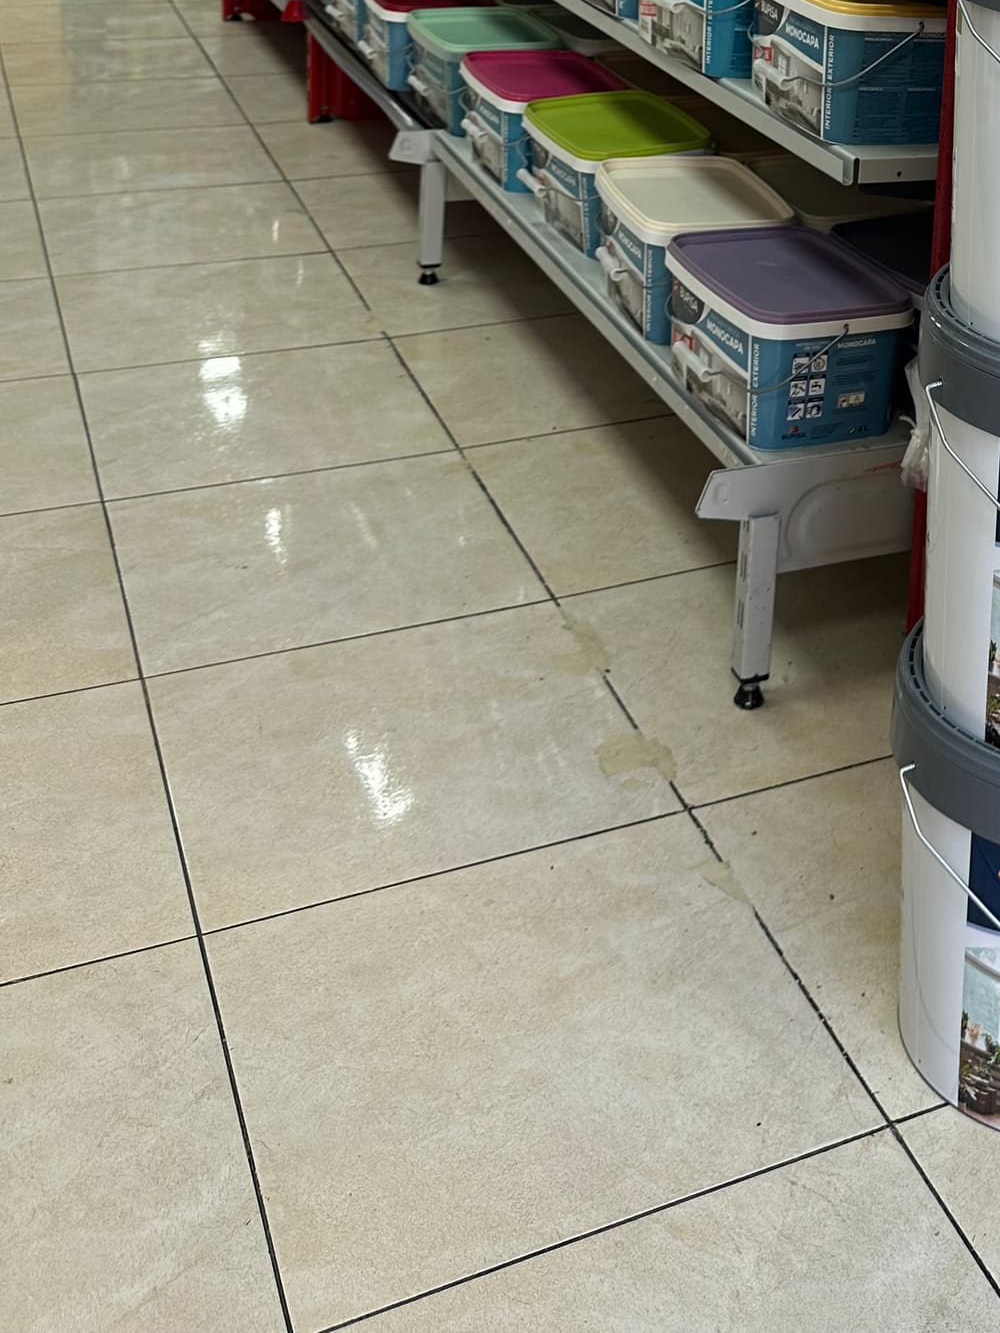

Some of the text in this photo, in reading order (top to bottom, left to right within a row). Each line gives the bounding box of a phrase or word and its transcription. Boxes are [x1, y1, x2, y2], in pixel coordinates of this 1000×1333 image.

[785, 22, 820, 50] MONOCAPA
[824, 34, 835, 131] INTERIOR EXTERIOR
[706, 318, 744, 355] MONOCAPA
[750, 342, 760, 437] INTERIOR EXTERIOR
